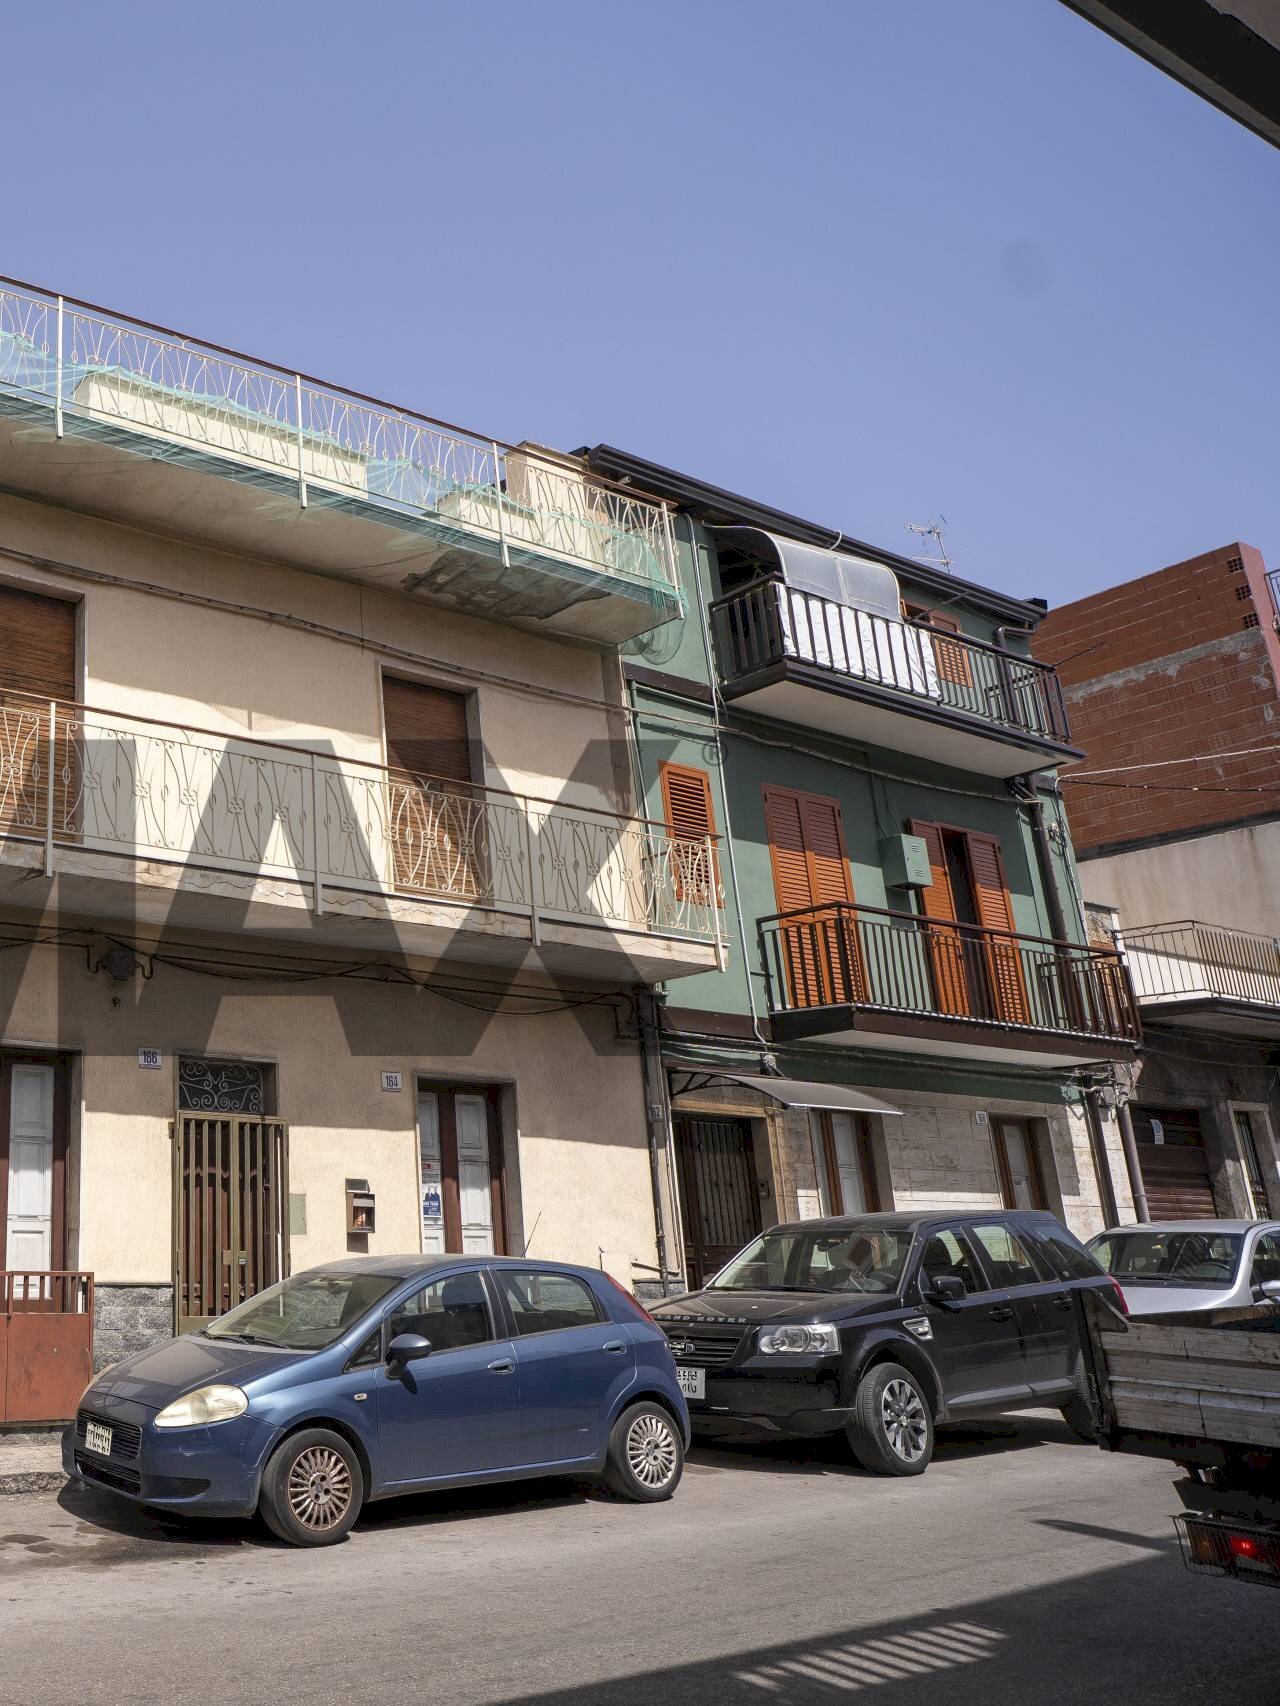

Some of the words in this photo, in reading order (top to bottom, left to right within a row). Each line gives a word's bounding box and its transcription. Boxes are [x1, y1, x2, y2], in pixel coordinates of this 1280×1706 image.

[143, 1050, 157, 1064] 166
[386, 1075, 398, 1087] 164
[696, 1316, 747, 1324] ROVER
